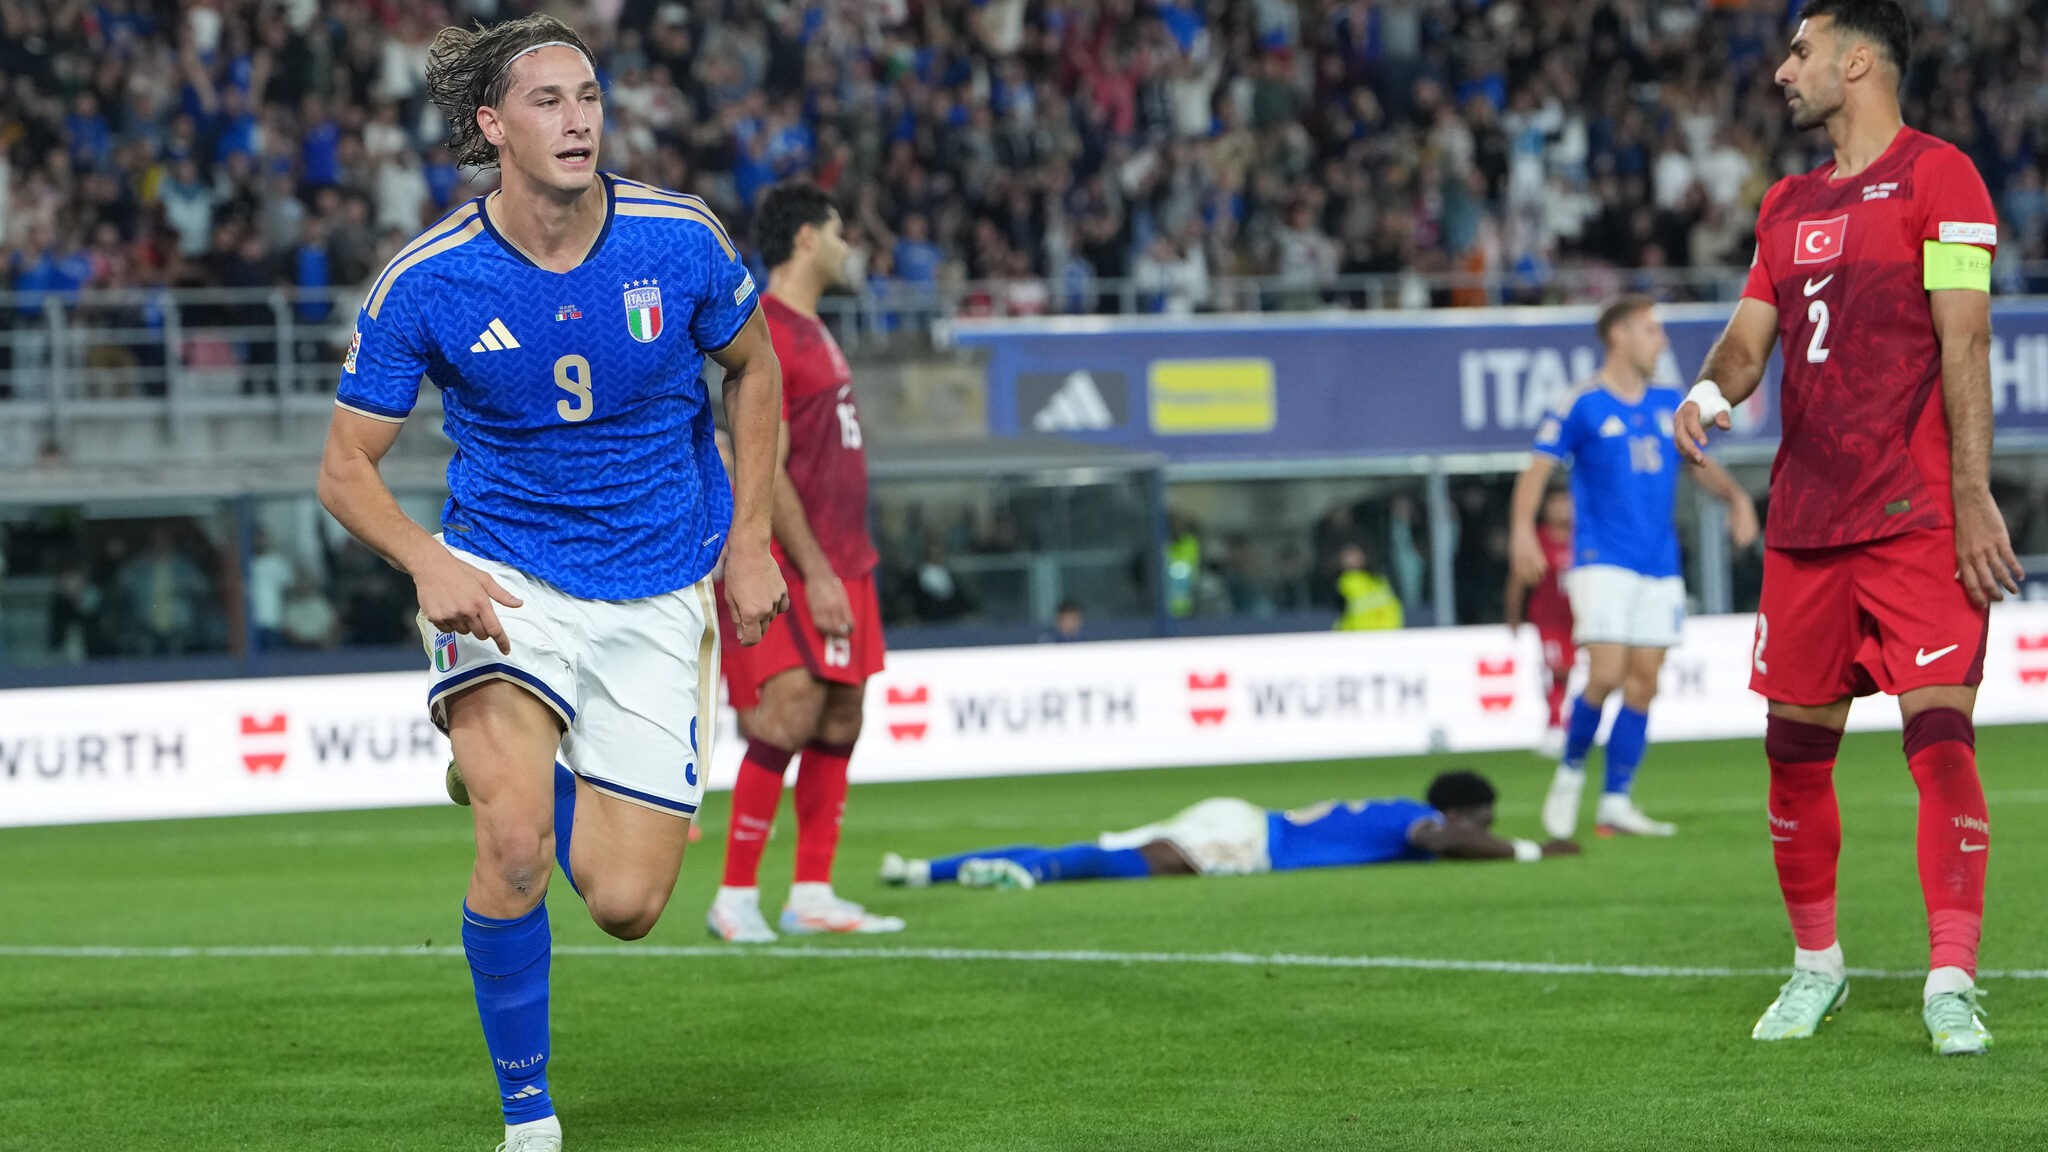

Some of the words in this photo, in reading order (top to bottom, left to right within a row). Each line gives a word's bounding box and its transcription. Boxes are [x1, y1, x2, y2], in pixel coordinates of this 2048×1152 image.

[626, 291, 658, 305] ITALIA
[1807, 299, 1830, 363] 2
[553, 354, 594, 422] 9
[496, 1053, 544, 1070] ITALIA
